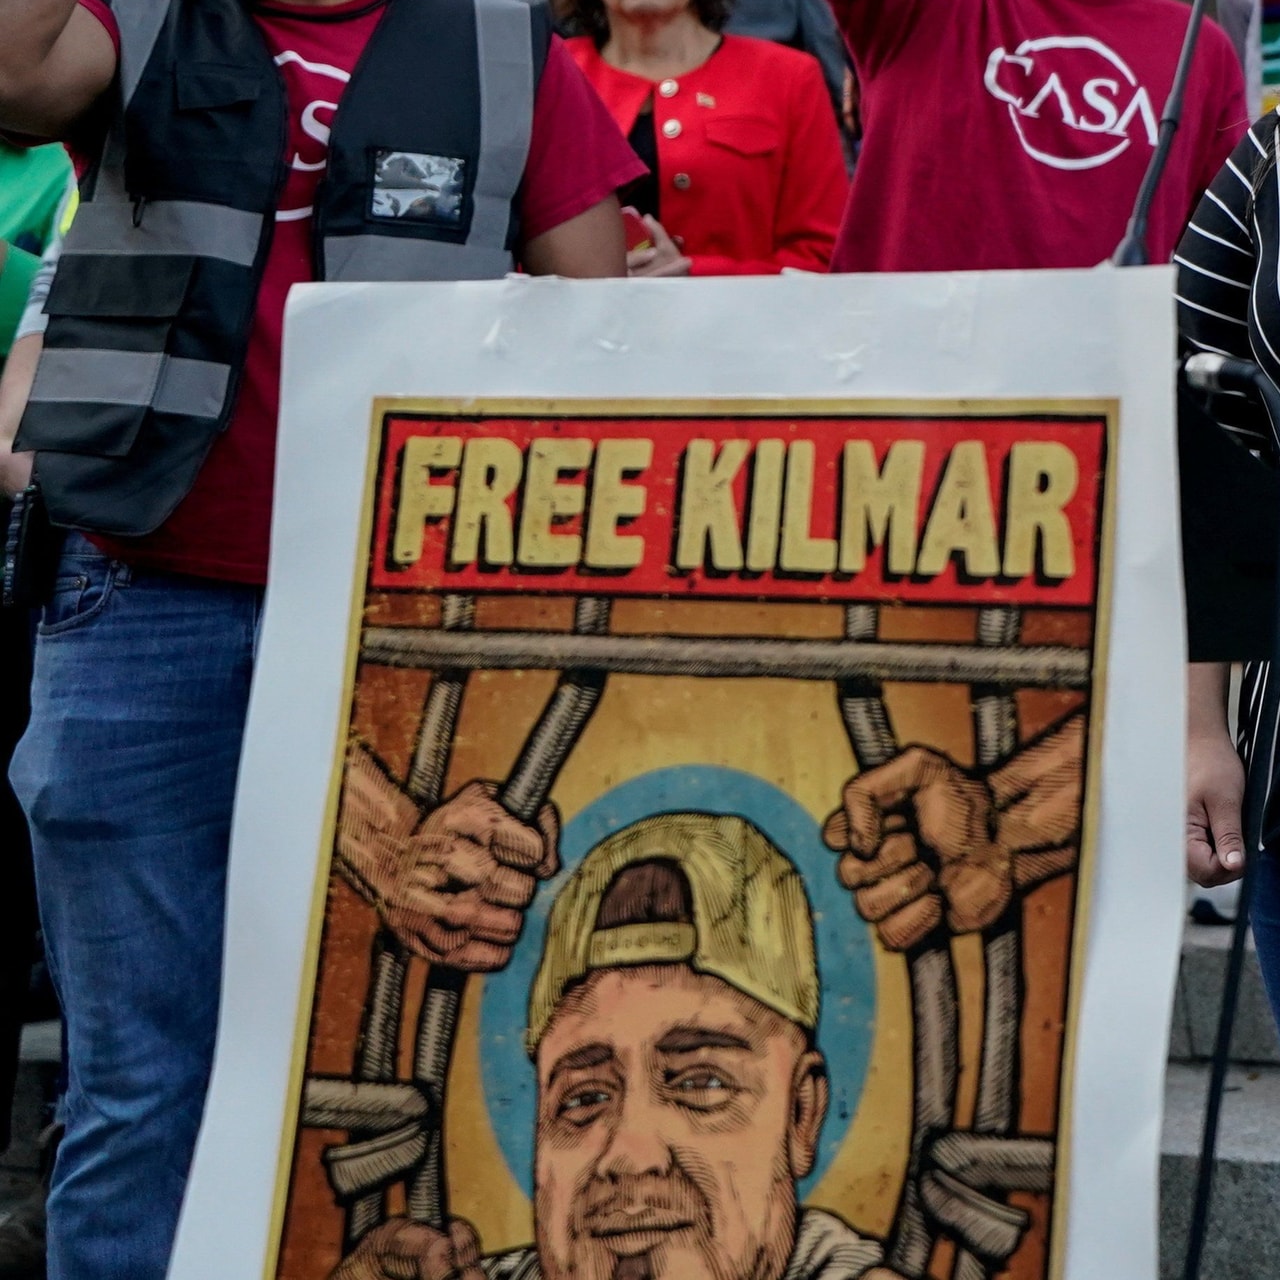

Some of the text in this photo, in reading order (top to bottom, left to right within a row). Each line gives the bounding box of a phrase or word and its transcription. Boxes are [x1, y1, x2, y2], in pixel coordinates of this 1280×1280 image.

[984, 46, 1160, 147] CASA
[389, 435, 1081, 580] FREE KILMAR
